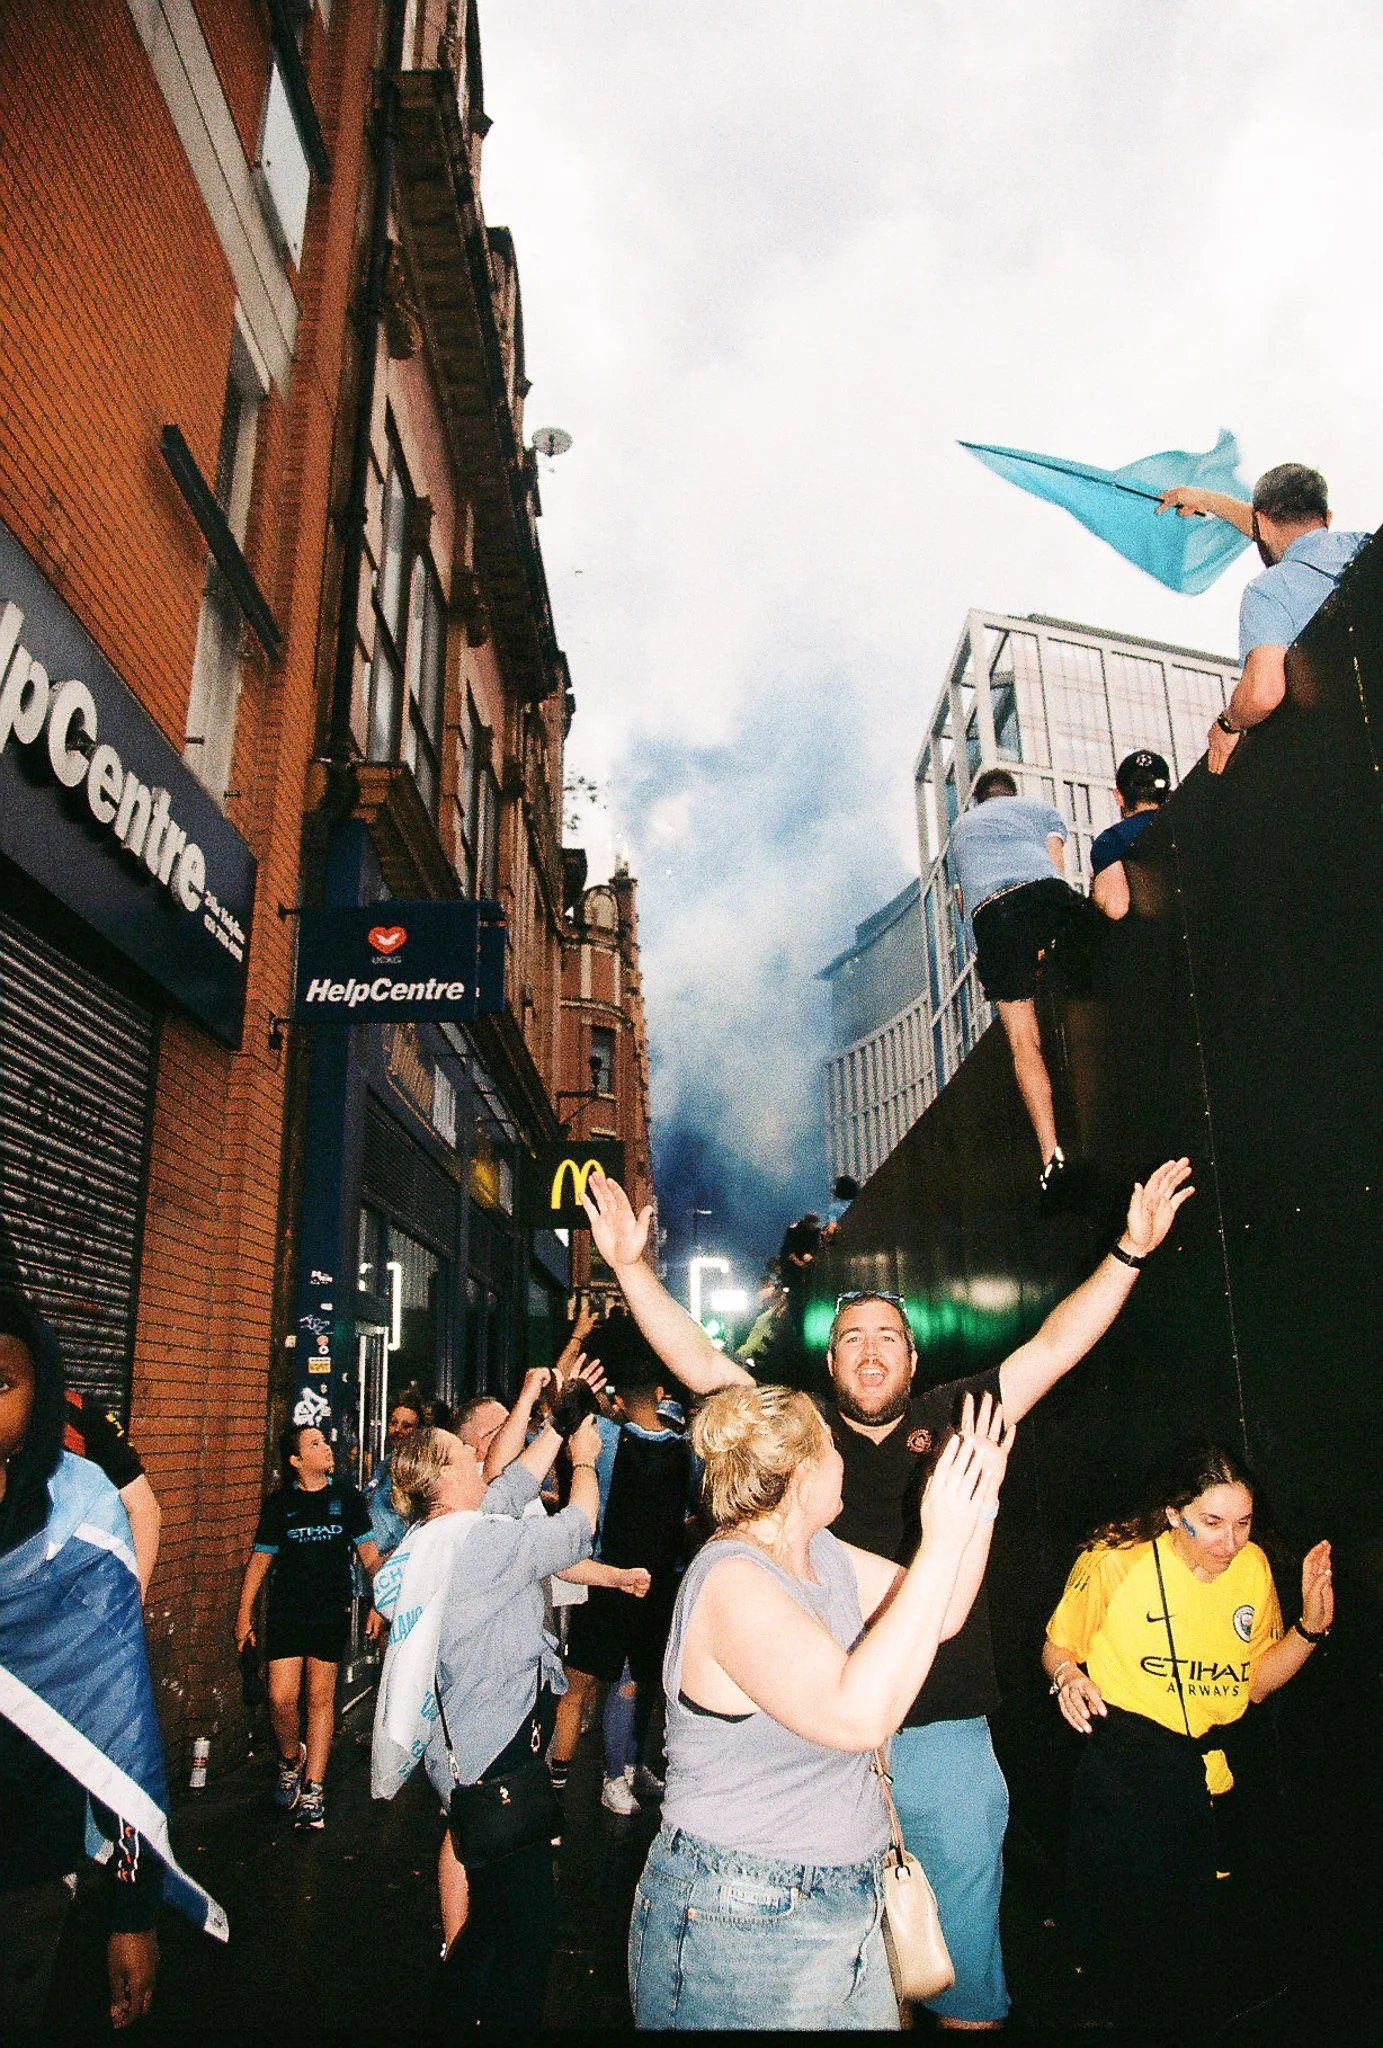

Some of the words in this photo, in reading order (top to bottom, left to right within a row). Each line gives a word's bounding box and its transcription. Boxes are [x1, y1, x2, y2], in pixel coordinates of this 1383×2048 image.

[306, 977, 465, 1007] HelpCentre
[287, 1525, 343, 1538] ETIHAD
[1166, 1682, 1240, 1696] ARWAYS
